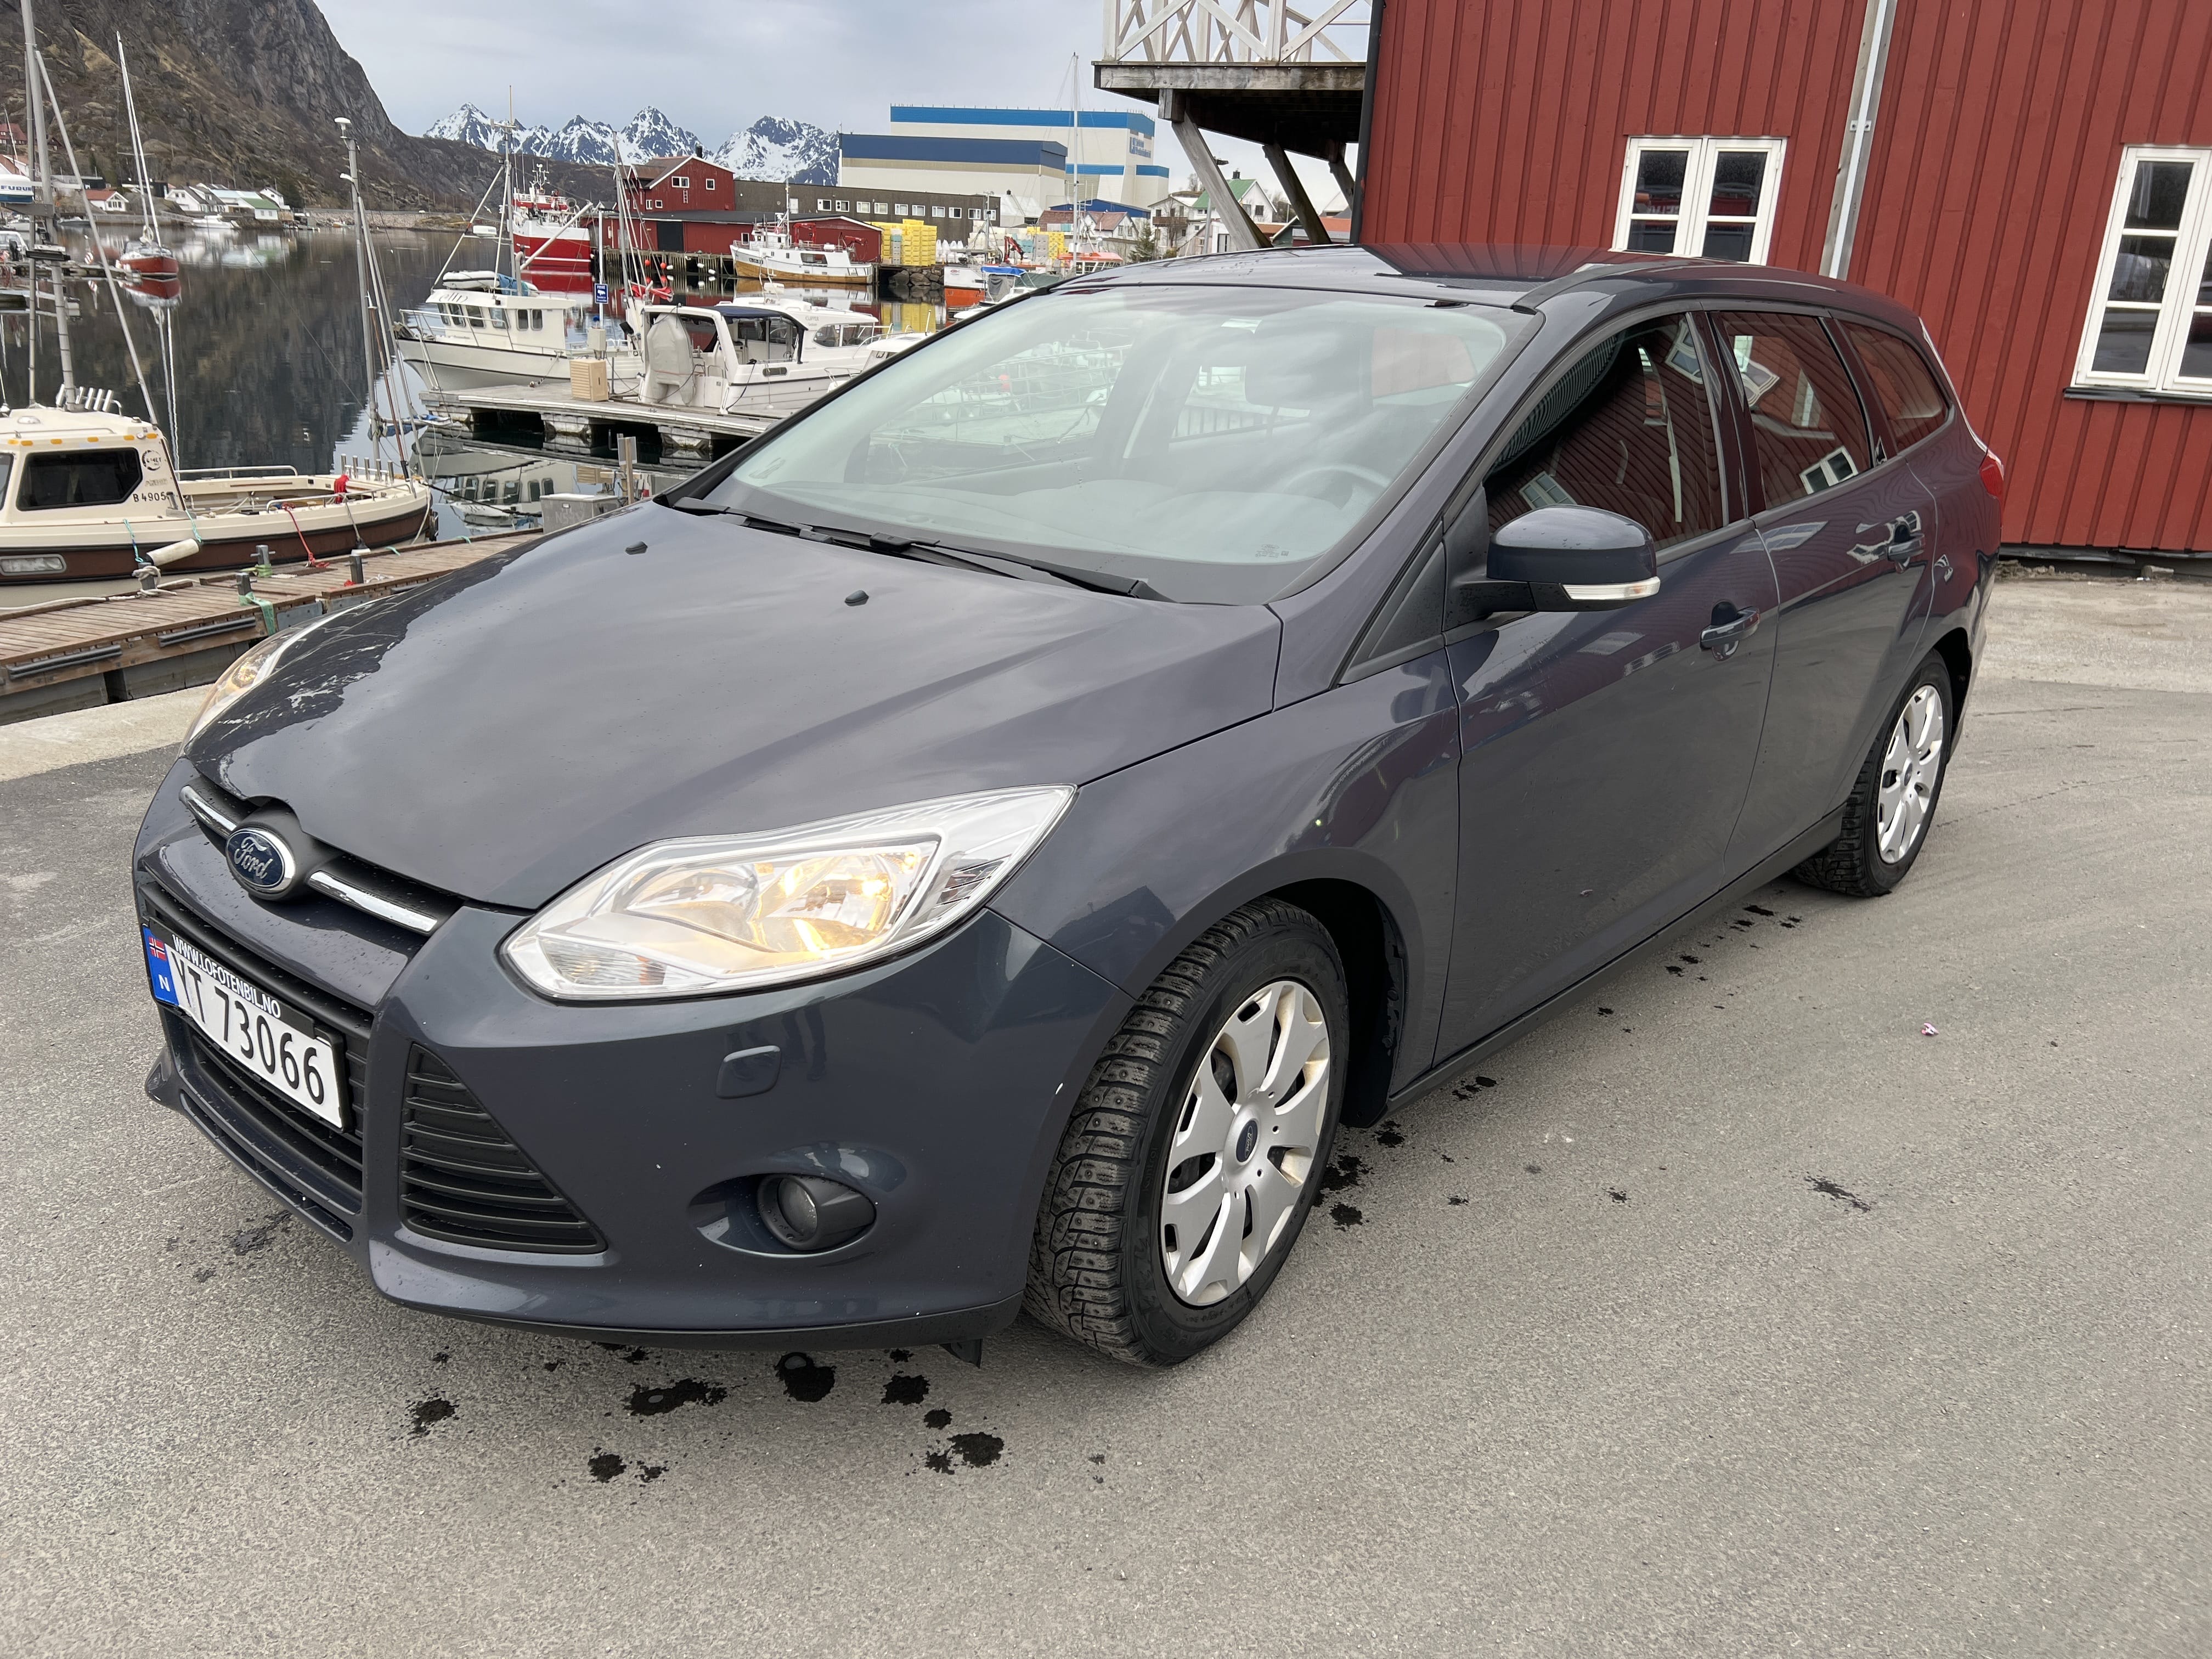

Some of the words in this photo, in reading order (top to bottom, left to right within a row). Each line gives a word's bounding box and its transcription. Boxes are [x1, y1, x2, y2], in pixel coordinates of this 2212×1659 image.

[133, 493, 139, 503] B
[234, 836, 274, 879] Ford
[158, 974, 171, 992] N
[172, 934, 281, 1019] WWW.LOFOTENBIL.NO
[171, 951, 206, 1024] YT
[215, 985, 324, 1105] 73066
